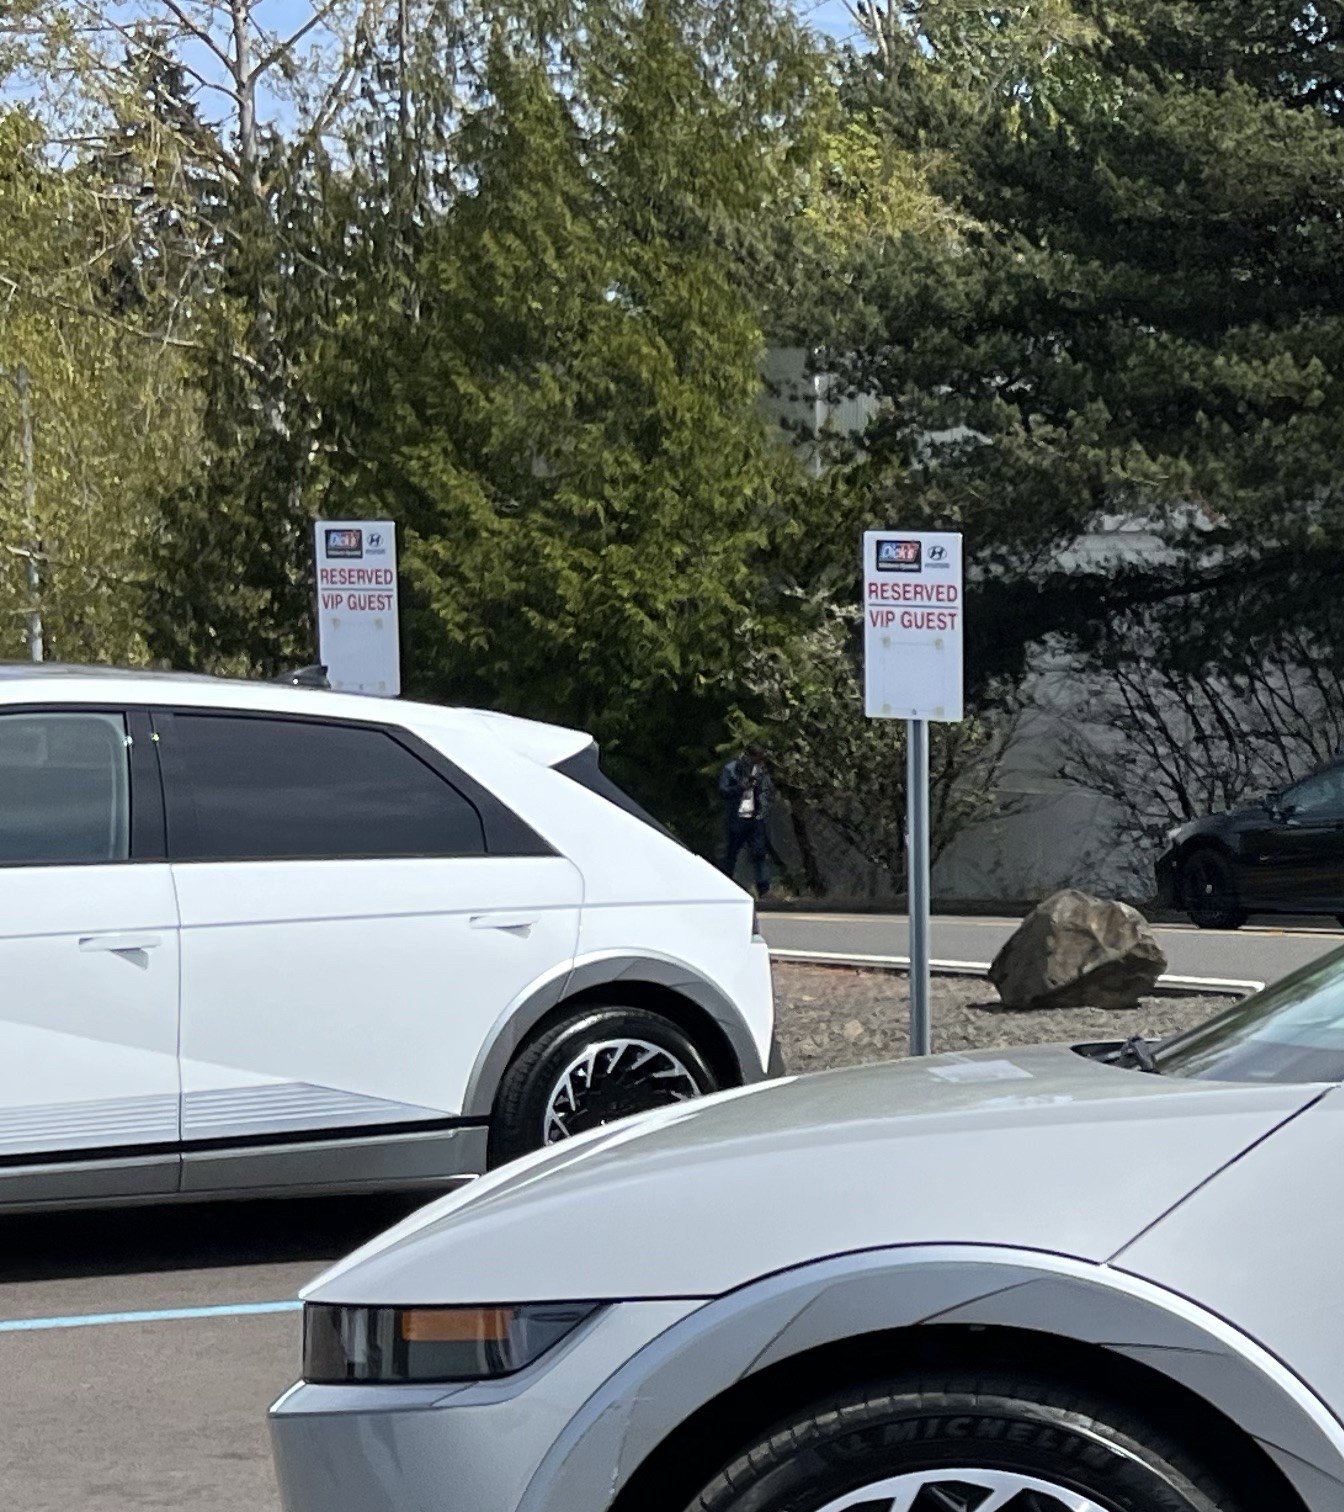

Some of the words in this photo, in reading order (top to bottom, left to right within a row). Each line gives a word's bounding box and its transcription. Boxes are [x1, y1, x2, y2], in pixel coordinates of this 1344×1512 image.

[320, 567, 394, 586] RESERVED
[321, 593, 344, 611] VIP
[347, 593, 394, 611] GUEST
[867, 582, 958, 602] RESERVED
[869, 609, 895, 628] VIP
[900, 610, 958, 630] GUEST
[882, 1415, 1116, 1469] MICHELIN
